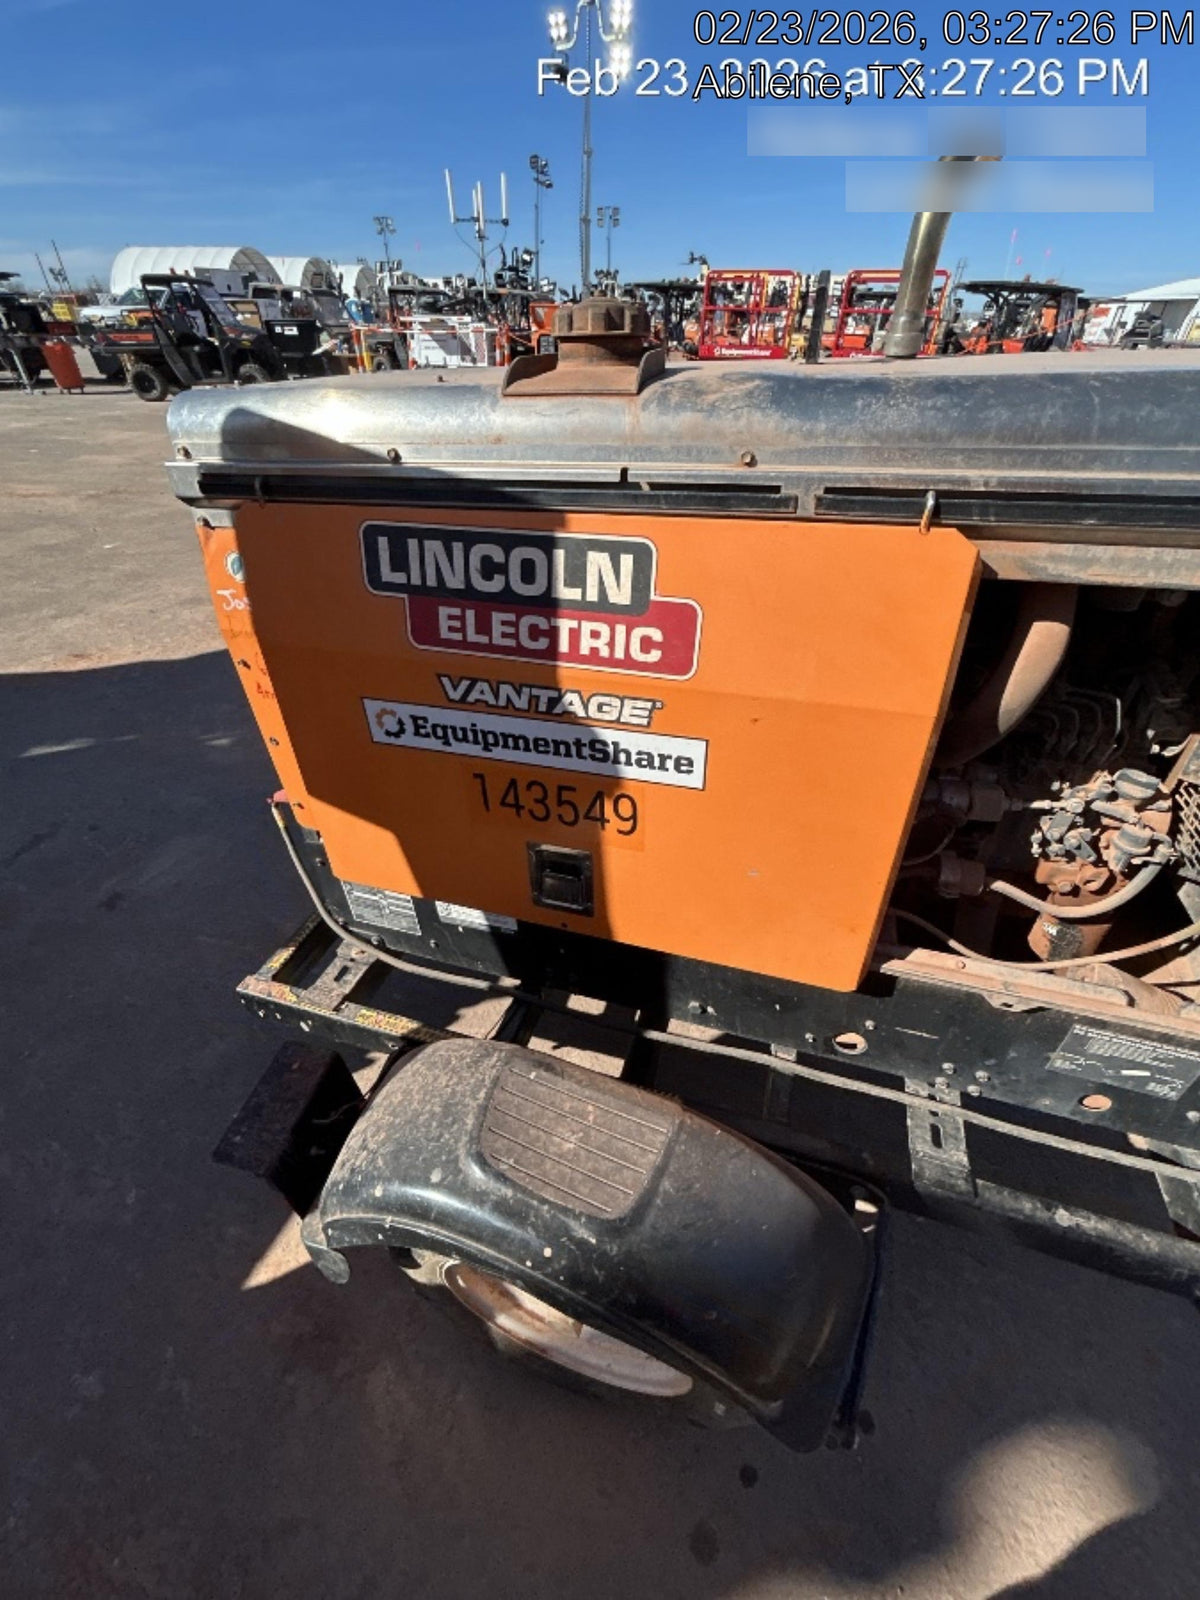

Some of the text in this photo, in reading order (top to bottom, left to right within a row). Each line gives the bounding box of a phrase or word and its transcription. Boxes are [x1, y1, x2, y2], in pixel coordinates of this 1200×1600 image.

[377, 535, 635, 606] LINCOLN
[438, 605, 664, 664] ELECTRIC
[409, 713, 696, 776] EquipmentShare
[473, 772, 638, 836] 143549
